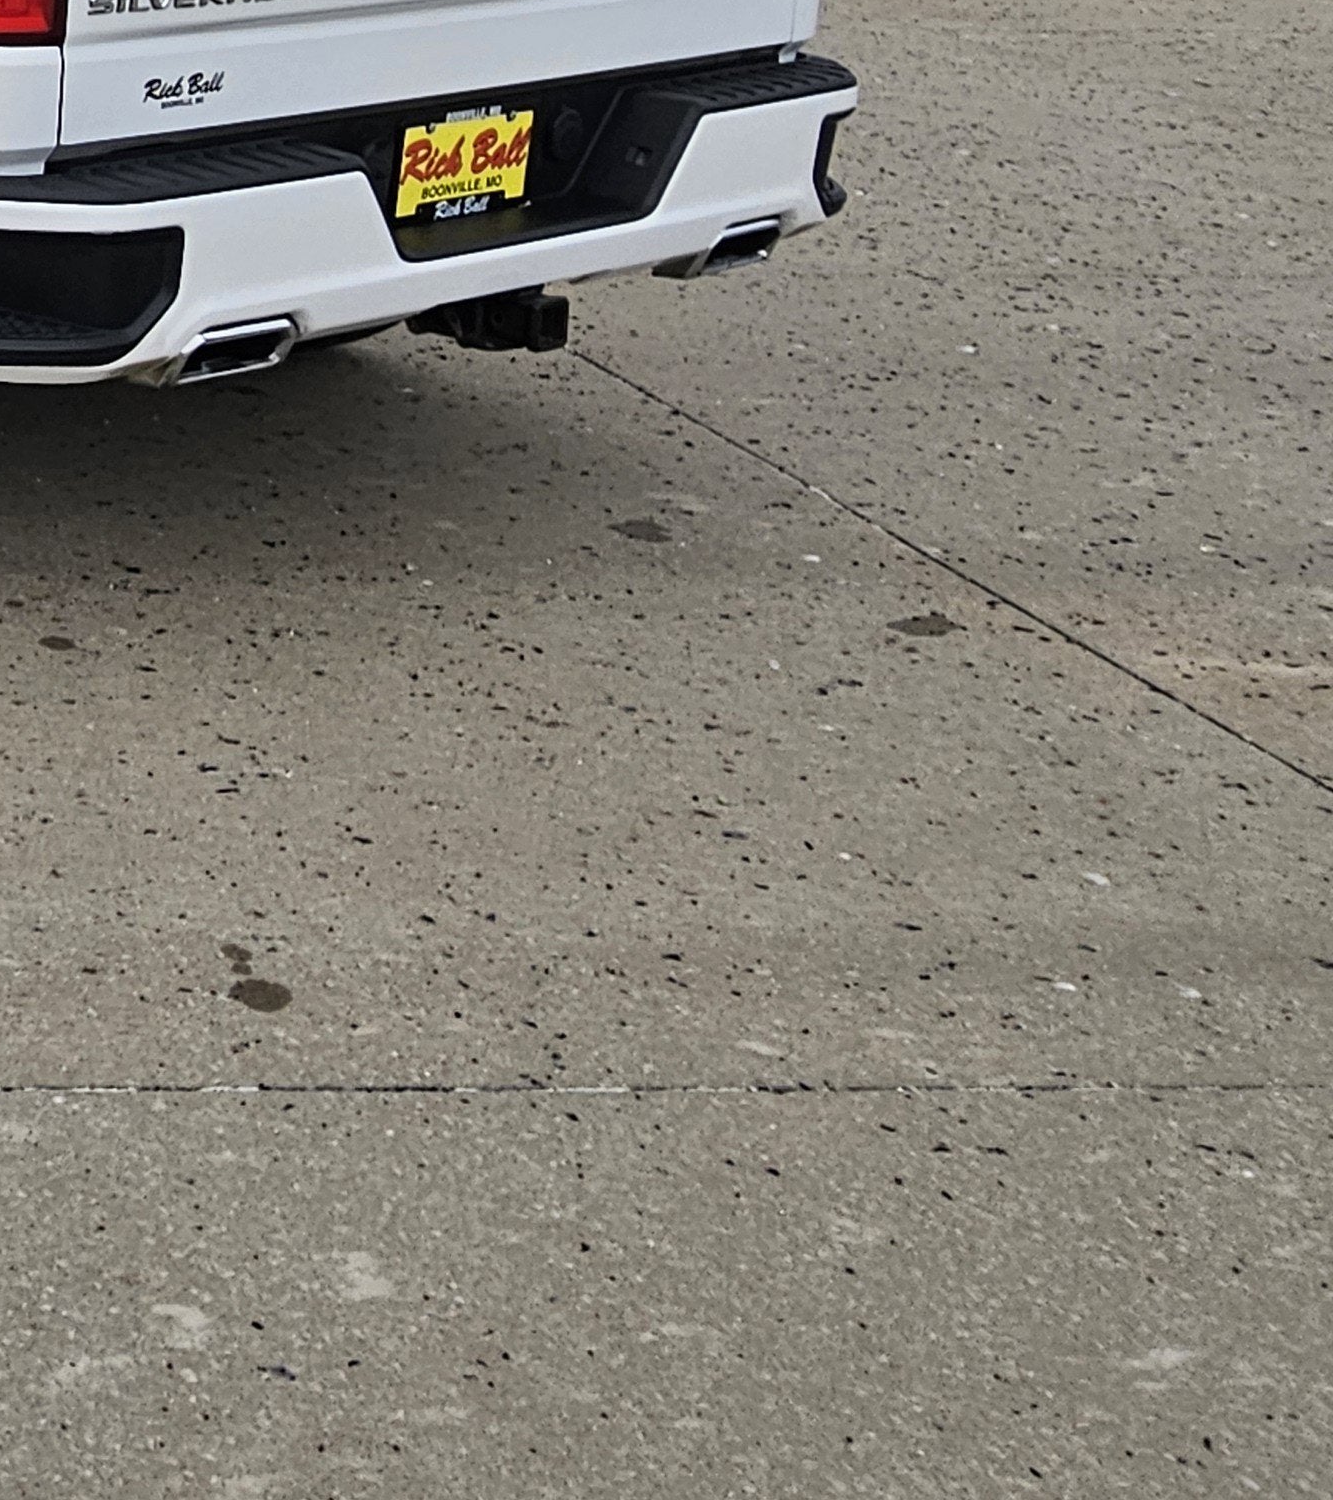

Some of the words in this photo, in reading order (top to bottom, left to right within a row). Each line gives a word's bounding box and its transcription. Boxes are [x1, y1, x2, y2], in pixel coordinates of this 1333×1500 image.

[142, 75, 185, 104] Rick
[186, 70, 225, 96] Ball
[400, 133, 466, 186] Rick
[470, 126, 532, 175] Ball
[486, 174, 503, 188] MO
